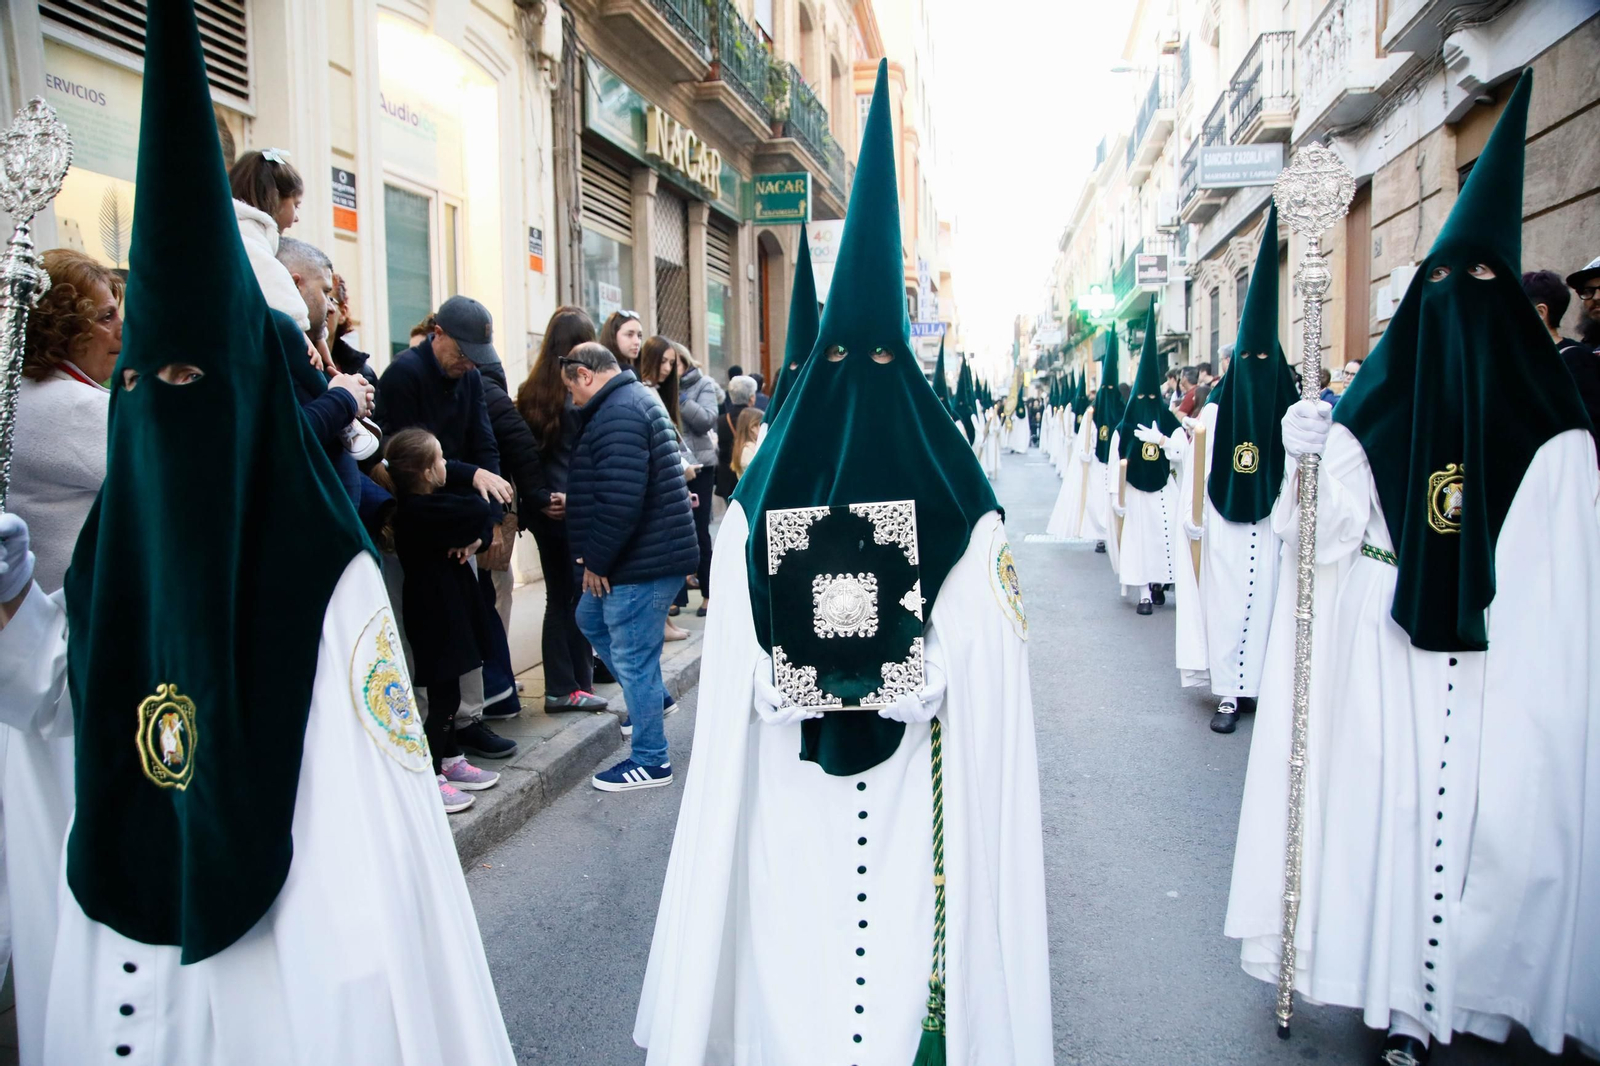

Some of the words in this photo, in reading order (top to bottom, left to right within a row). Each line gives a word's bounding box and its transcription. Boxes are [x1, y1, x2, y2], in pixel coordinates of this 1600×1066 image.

[45, 73, 106, 106] ERVICIOS
[645, 104, 722, 199] NACAR
[755, 179, 805, 195] NACAR
[919, 261, 928, 320] HOTEL
[911, 322, 945, 336] EVILLA
